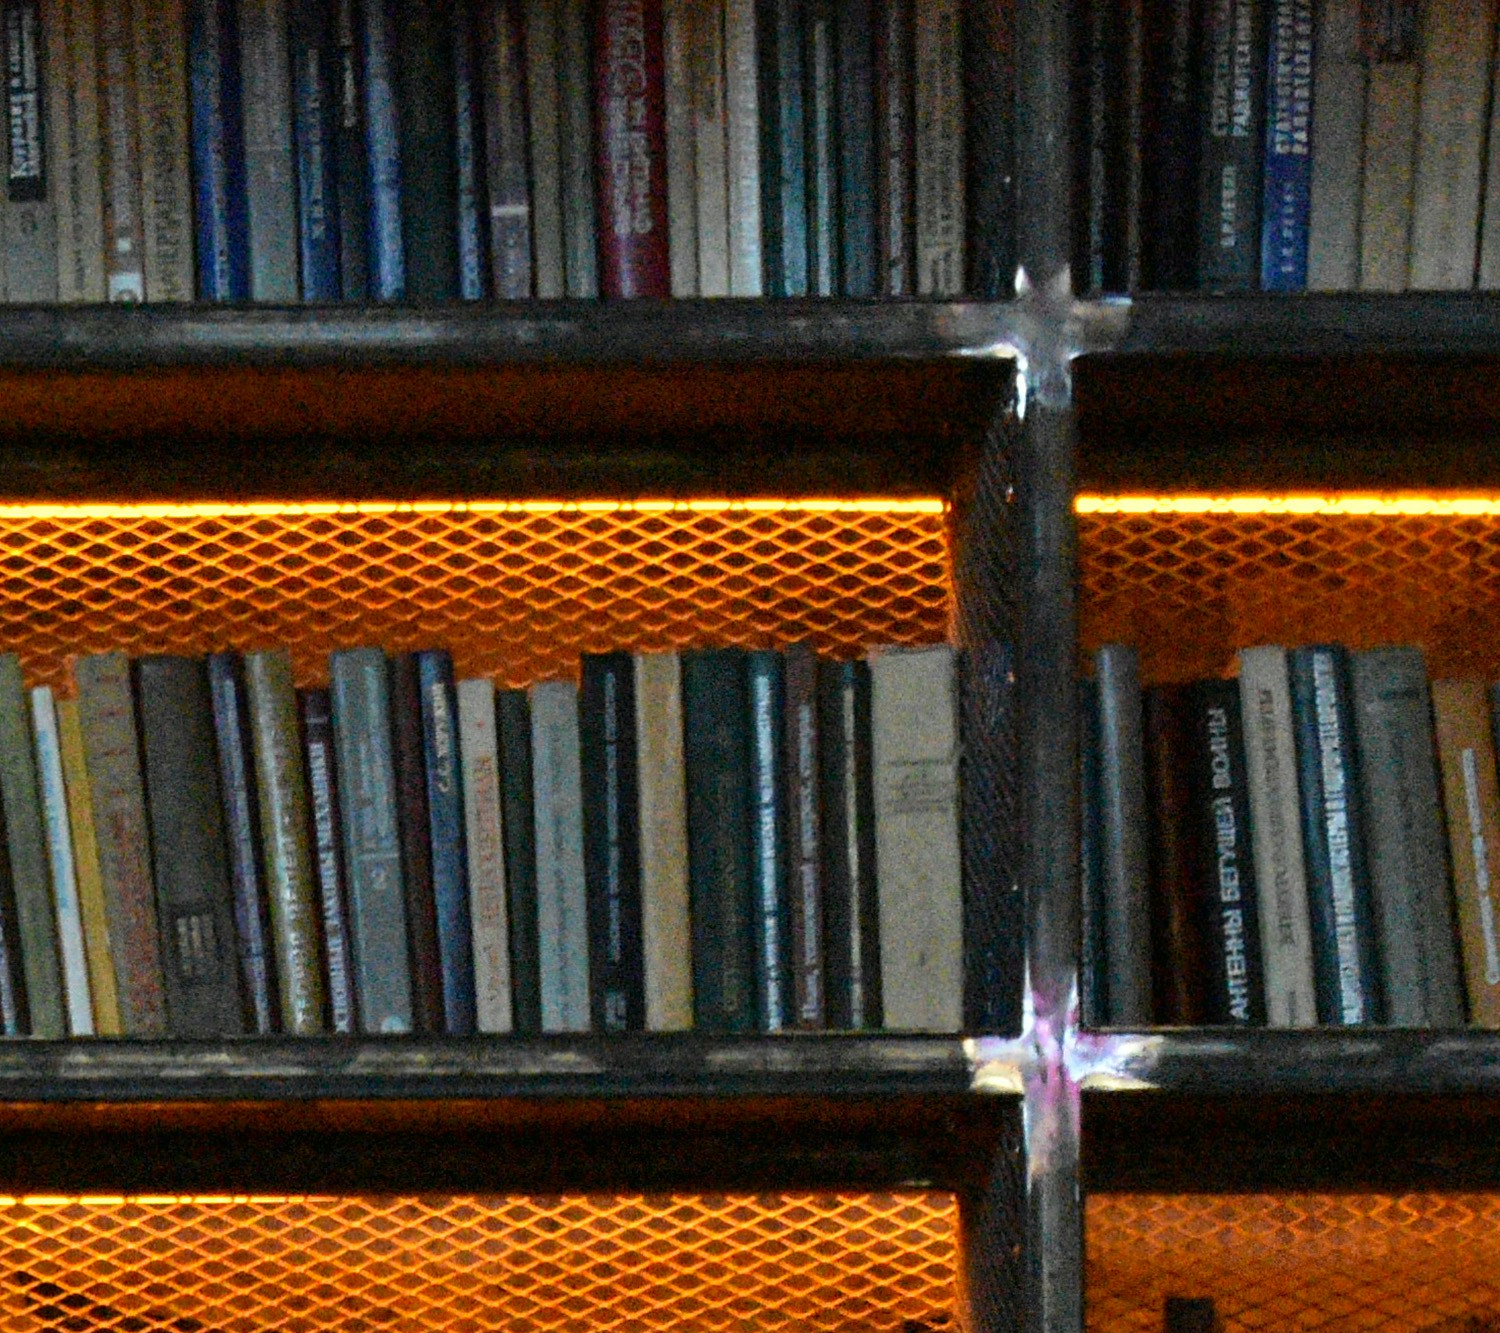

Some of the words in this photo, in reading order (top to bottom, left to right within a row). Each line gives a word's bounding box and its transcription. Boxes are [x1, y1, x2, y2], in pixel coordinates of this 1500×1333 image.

[1204, 706, 1233, 791] ВОЛНЫ
[1210, 797, 1242, 904] БЕГУЩЕЙ
[1216, 913, 1251, 1022] АНТЕННЫ
